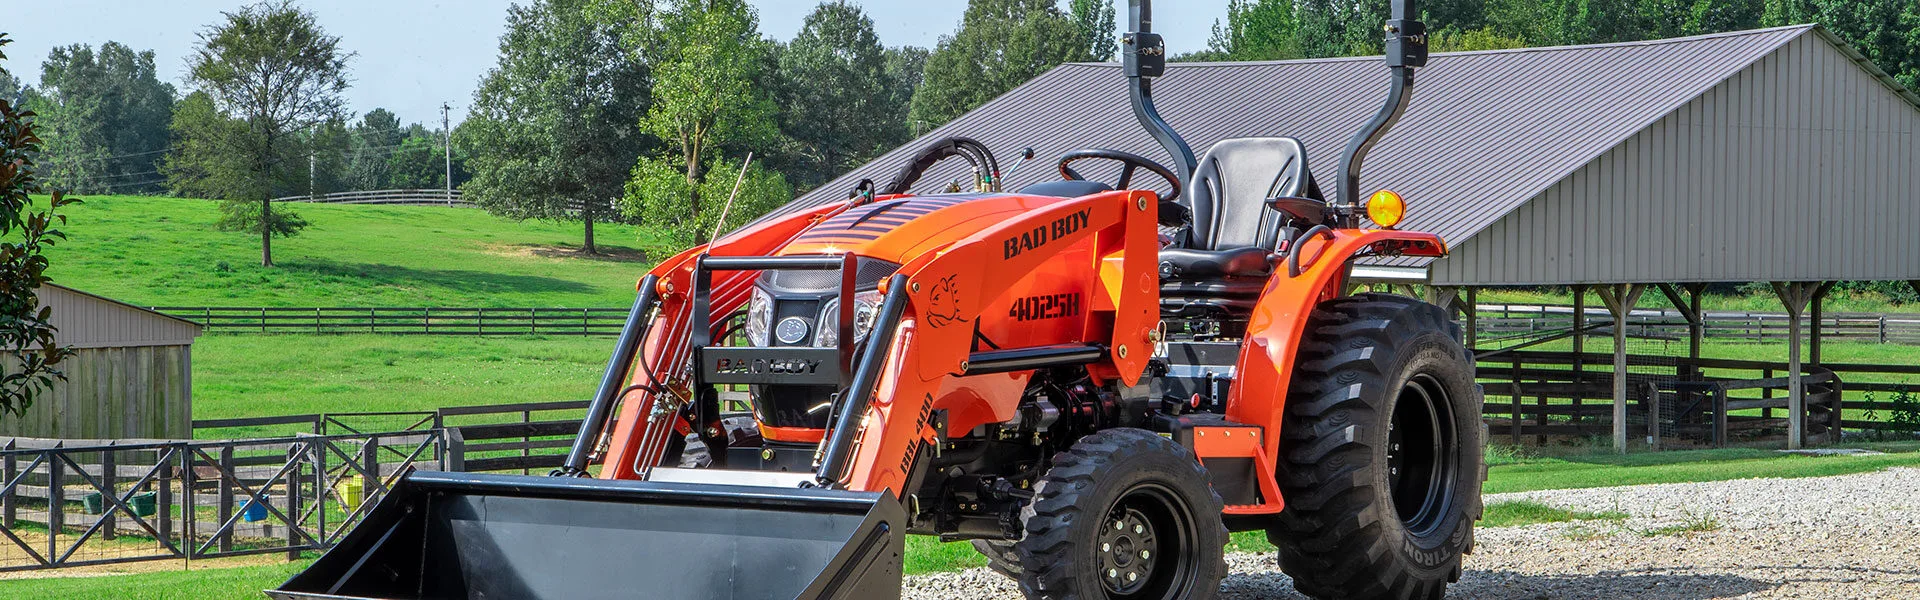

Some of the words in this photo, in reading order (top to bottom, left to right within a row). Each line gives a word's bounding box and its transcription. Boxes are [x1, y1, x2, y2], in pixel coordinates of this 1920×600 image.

[1003, 225, 1047, 260] BAD
[1051, 207, 1092, 241] BOY
[1009, 293, 1080, 322] 4025H
[716, 358, 763, 374] BAD
[768, 358, 824, 375] BOY
[1404, 539, 1451, 567] TIRON
